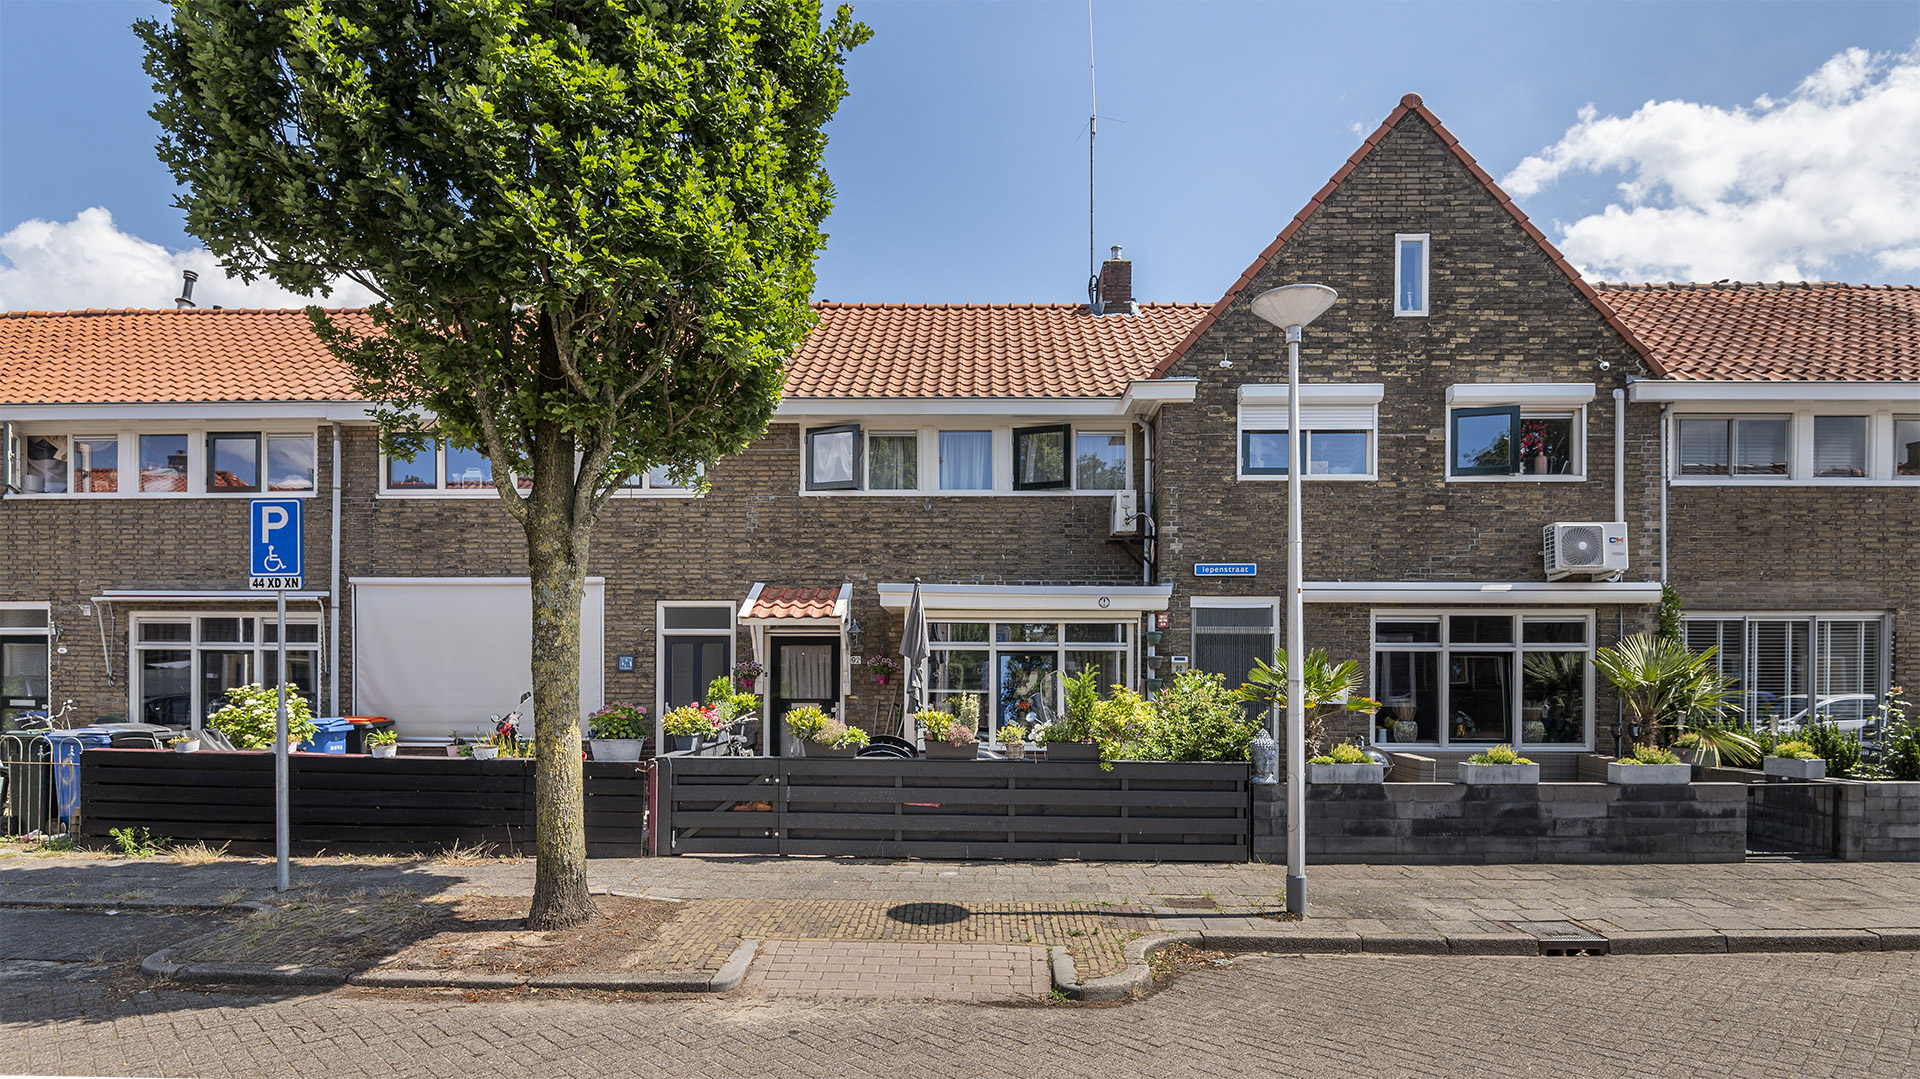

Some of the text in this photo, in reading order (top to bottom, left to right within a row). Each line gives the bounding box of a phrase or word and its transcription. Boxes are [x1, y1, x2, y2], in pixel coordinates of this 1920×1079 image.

[261, 505, 289, 544] P
[1202, 566, 1249, 574] Iepenstraat
[252, 577, 299, 589] 44 XD XN
